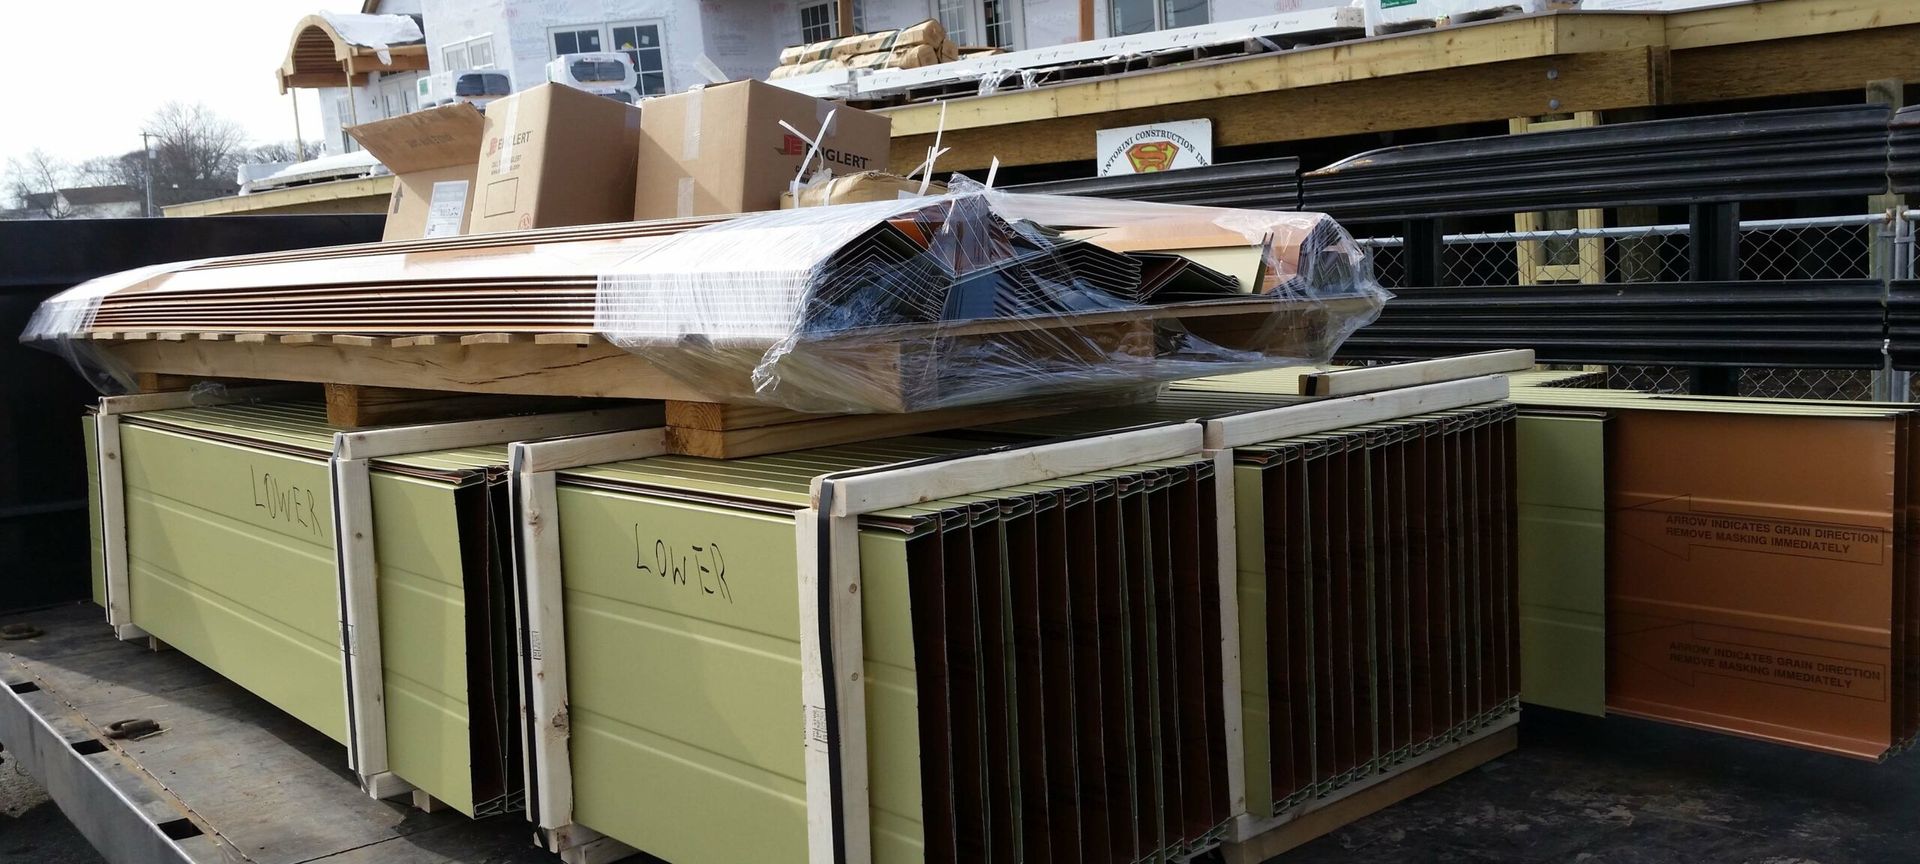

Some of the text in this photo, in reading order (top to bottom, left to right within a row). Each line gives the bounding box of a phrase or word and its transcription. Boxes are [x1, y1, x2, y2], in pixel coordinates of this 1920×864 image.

[498, 131, 532, 150] ELERT
[1100, 136, 1134, 176] ANTORINI
[1135, 129, 1196, 153] CONSTRUCTION
[250, 464, 323, 537] LOWER
[1665, 514, 1879, 544] ARROW INDICATES GRAIN DIRECTION
[1665, 527, 1850, 554] REMOVE MASKING IMMEDIATELY
[635, 523, 733, 605] LOWER
[1669, 641, 1880, 681] ARROW INDICATES GRAIN DIRECTION
[1669, 653, 1852, 689] REMOVE MASKING IMMEDIATELY
